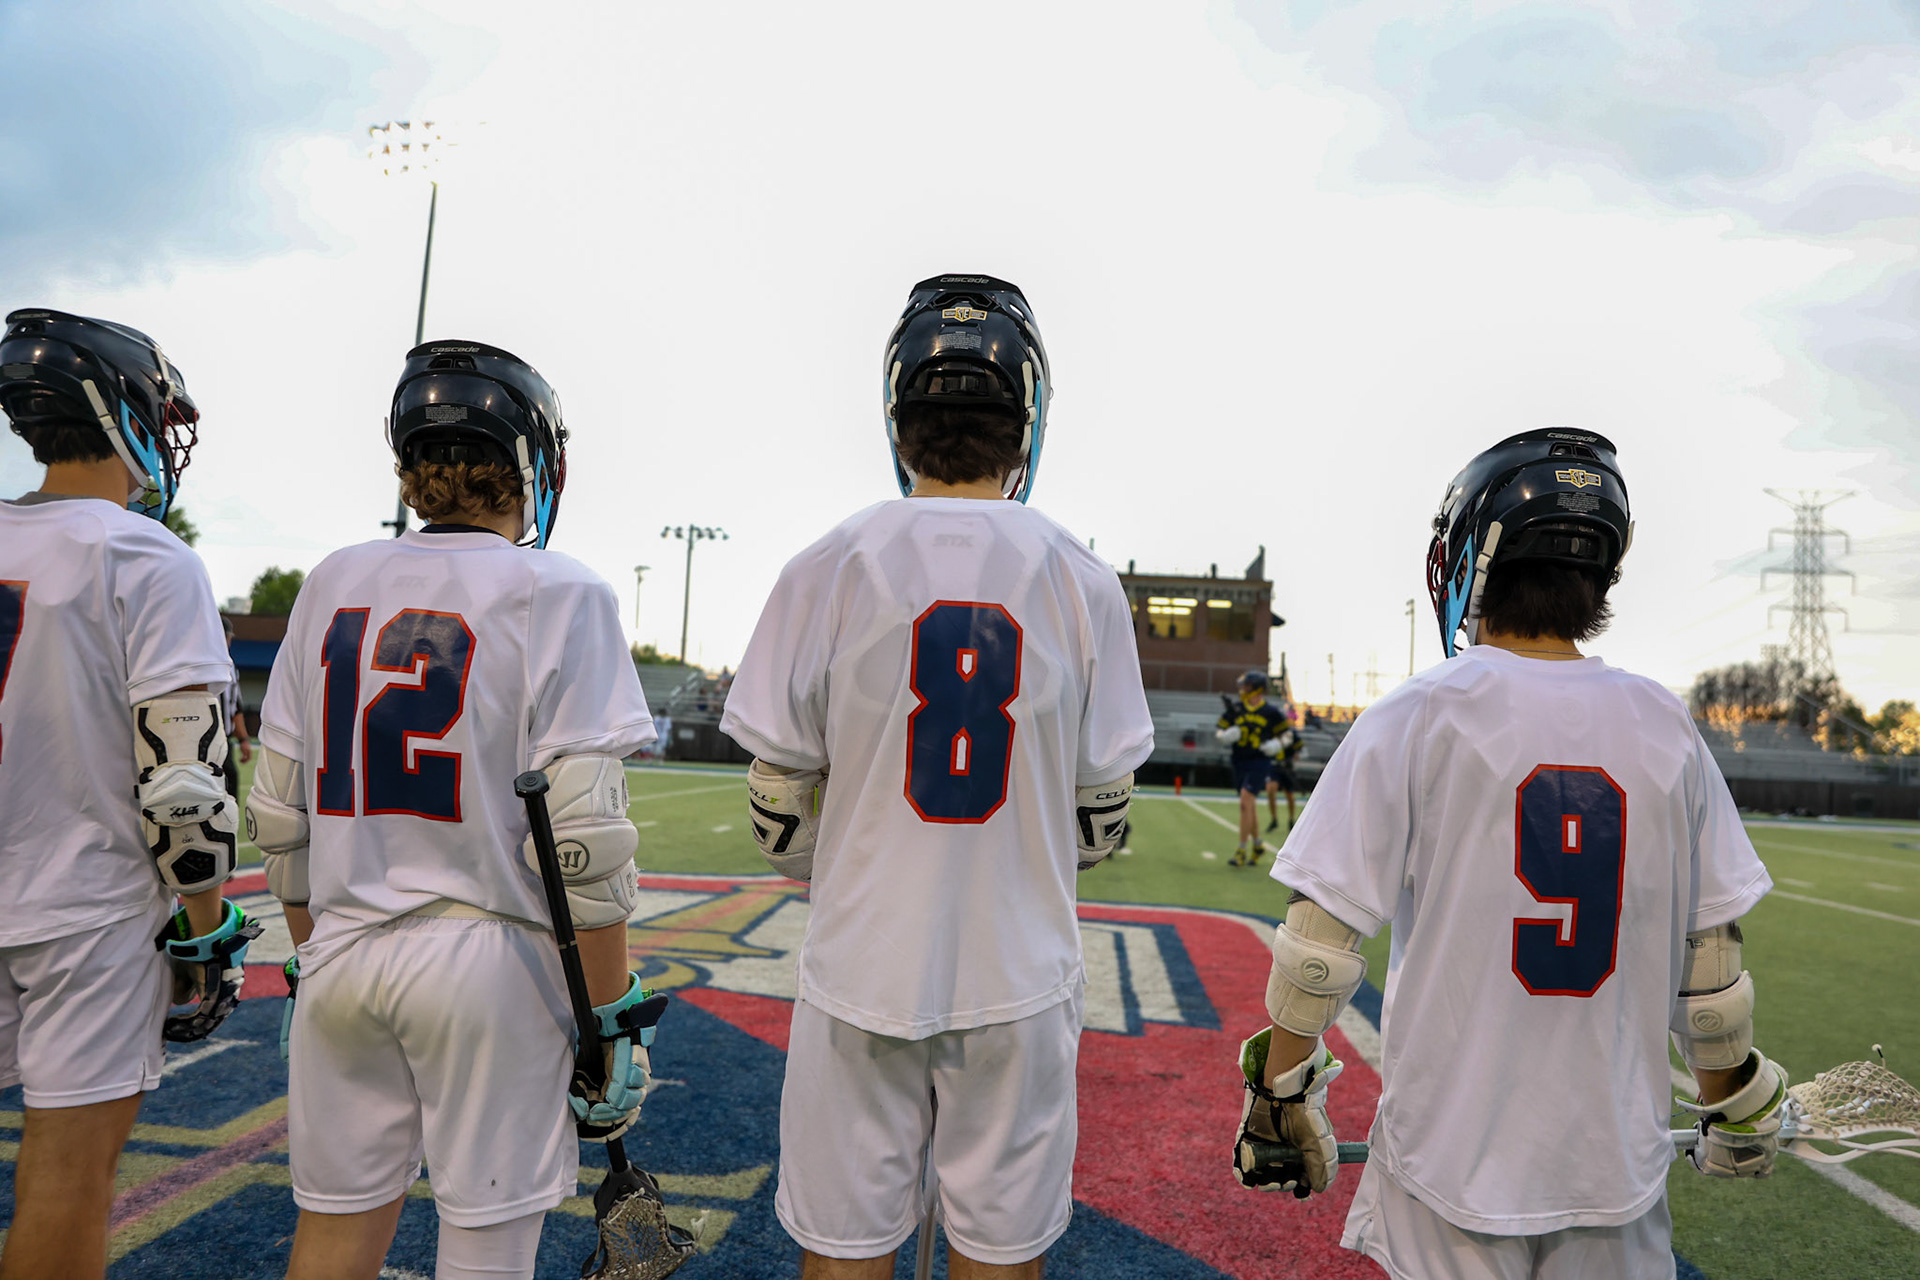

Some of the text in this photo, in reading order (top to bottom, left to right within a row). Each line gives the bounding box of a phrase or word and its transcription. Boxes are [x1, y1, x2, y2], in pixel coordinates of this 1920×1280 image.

[940, 276, 990, 284] cascade
[430, 345, 481, 353] cascade
[1546, 432, 1599, 443] cascade
[317, 607, 477, 823] 12
[903, 599, 1024, 824] 8
[1096, 788, 1127, 800] CELL
[1512, 763, 1627, 998] 9
